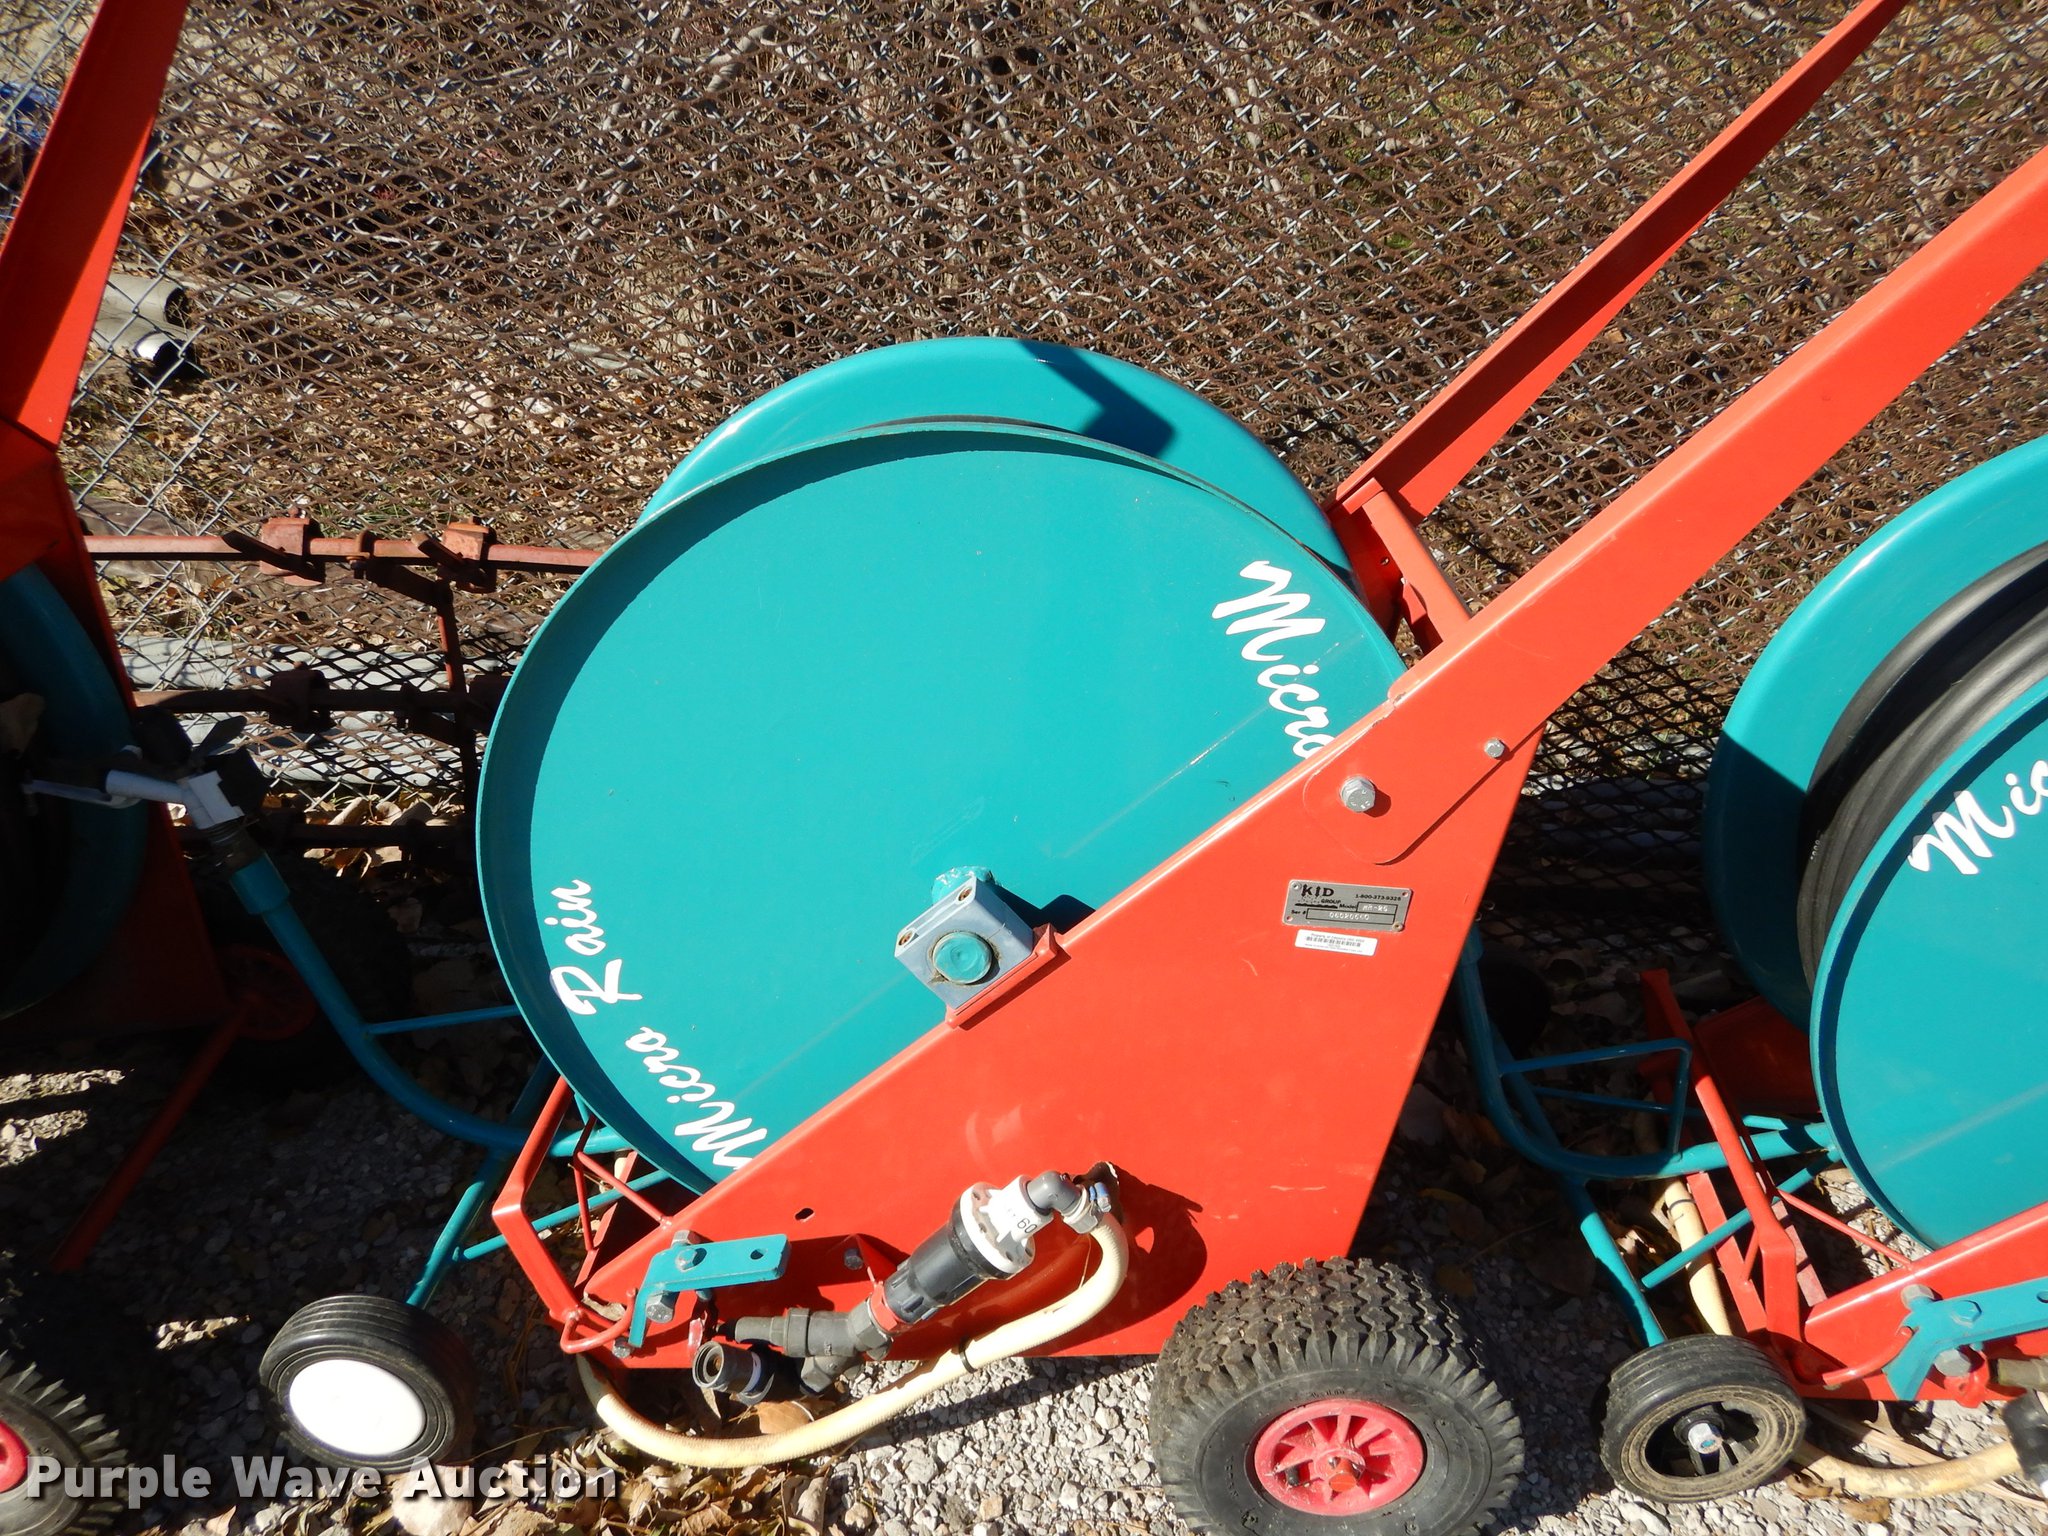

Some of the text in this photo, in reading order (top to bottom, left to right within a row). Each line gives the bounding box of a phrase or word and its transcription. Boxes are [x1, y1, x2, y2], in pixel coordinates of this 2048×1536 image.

[1211, 559, 1336, 760] Micro
[1301, 884, 1335, 897] KID
[544, 879, 768, 1170] Micro Rain
[1017, 1218, 1037, 1233] 60
